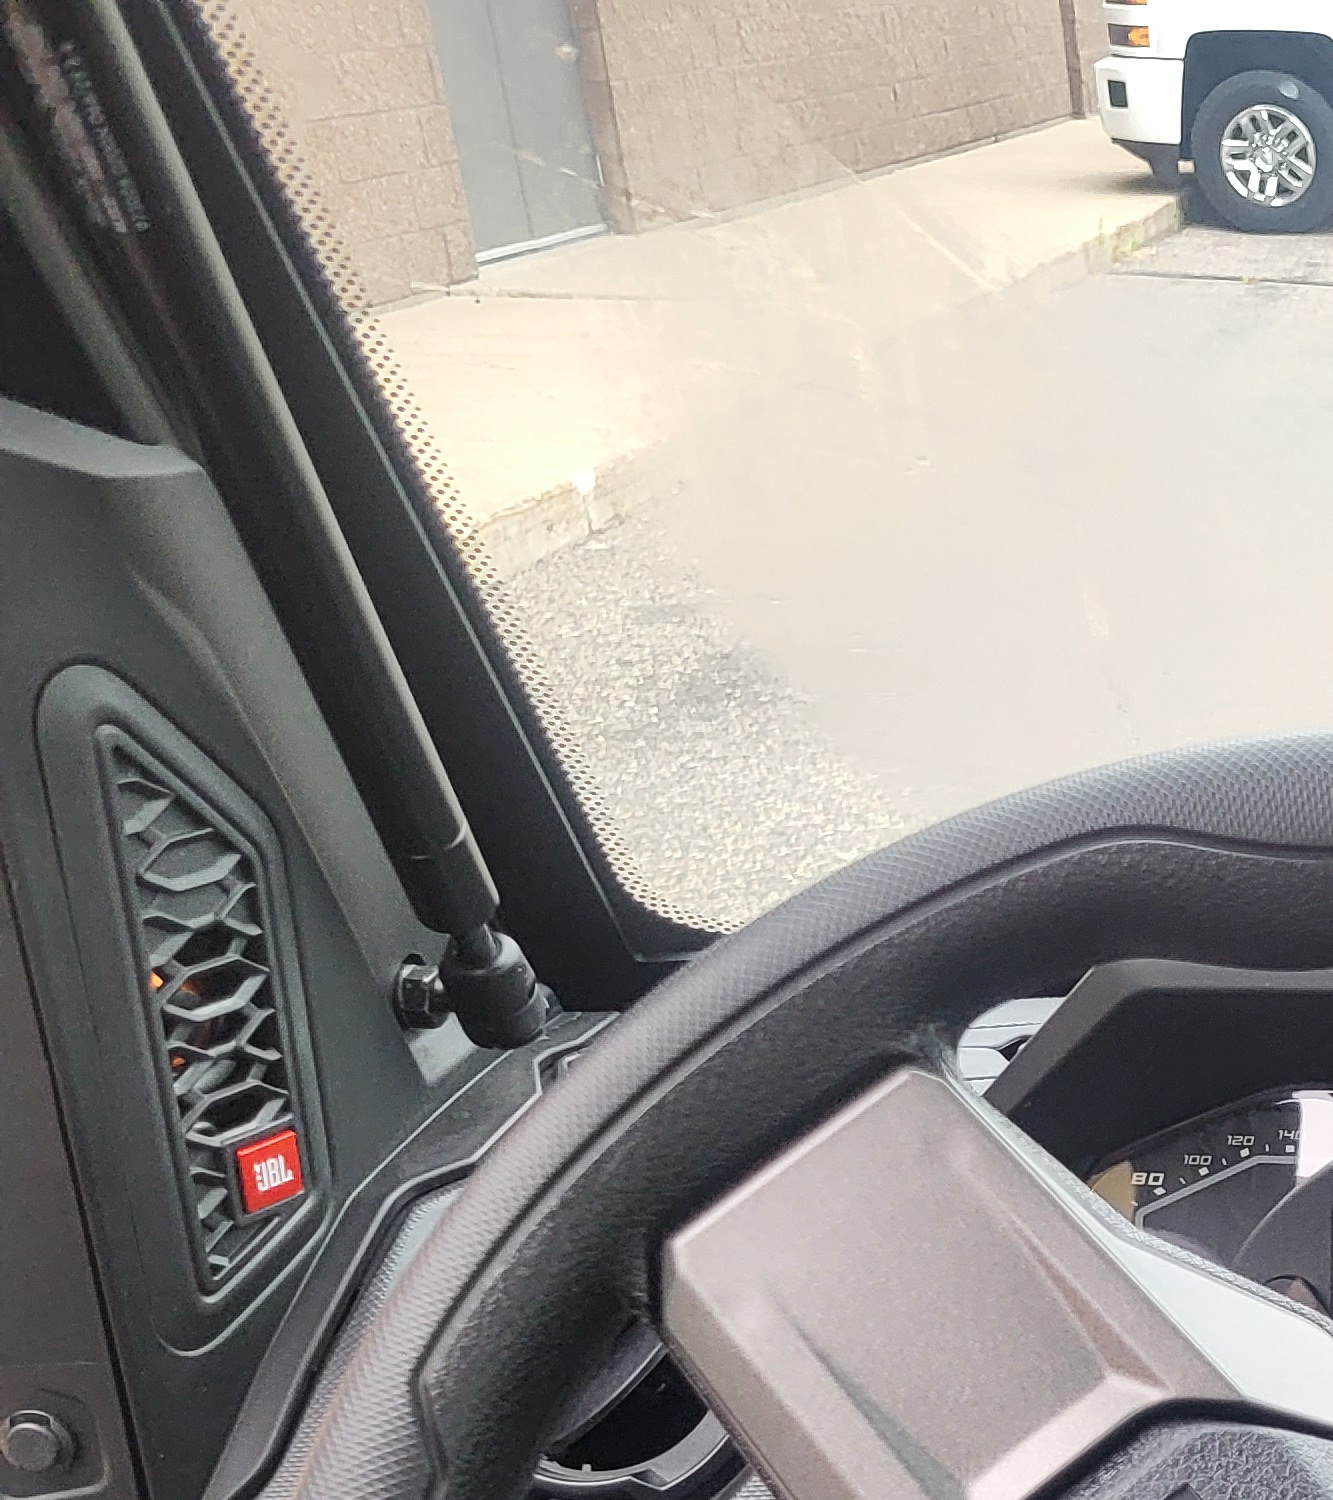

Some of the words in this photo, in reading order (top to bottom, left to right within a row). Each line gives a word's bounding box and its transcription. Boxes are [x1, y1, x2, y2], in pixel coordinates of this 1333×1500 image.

[1226, 1135, 1255, 1147] 120
[1183, 1154, 1213, 1166] 100
[253, 1153, 295, 1193] JBL
[1131, 1172, 1165, 1186] 80
